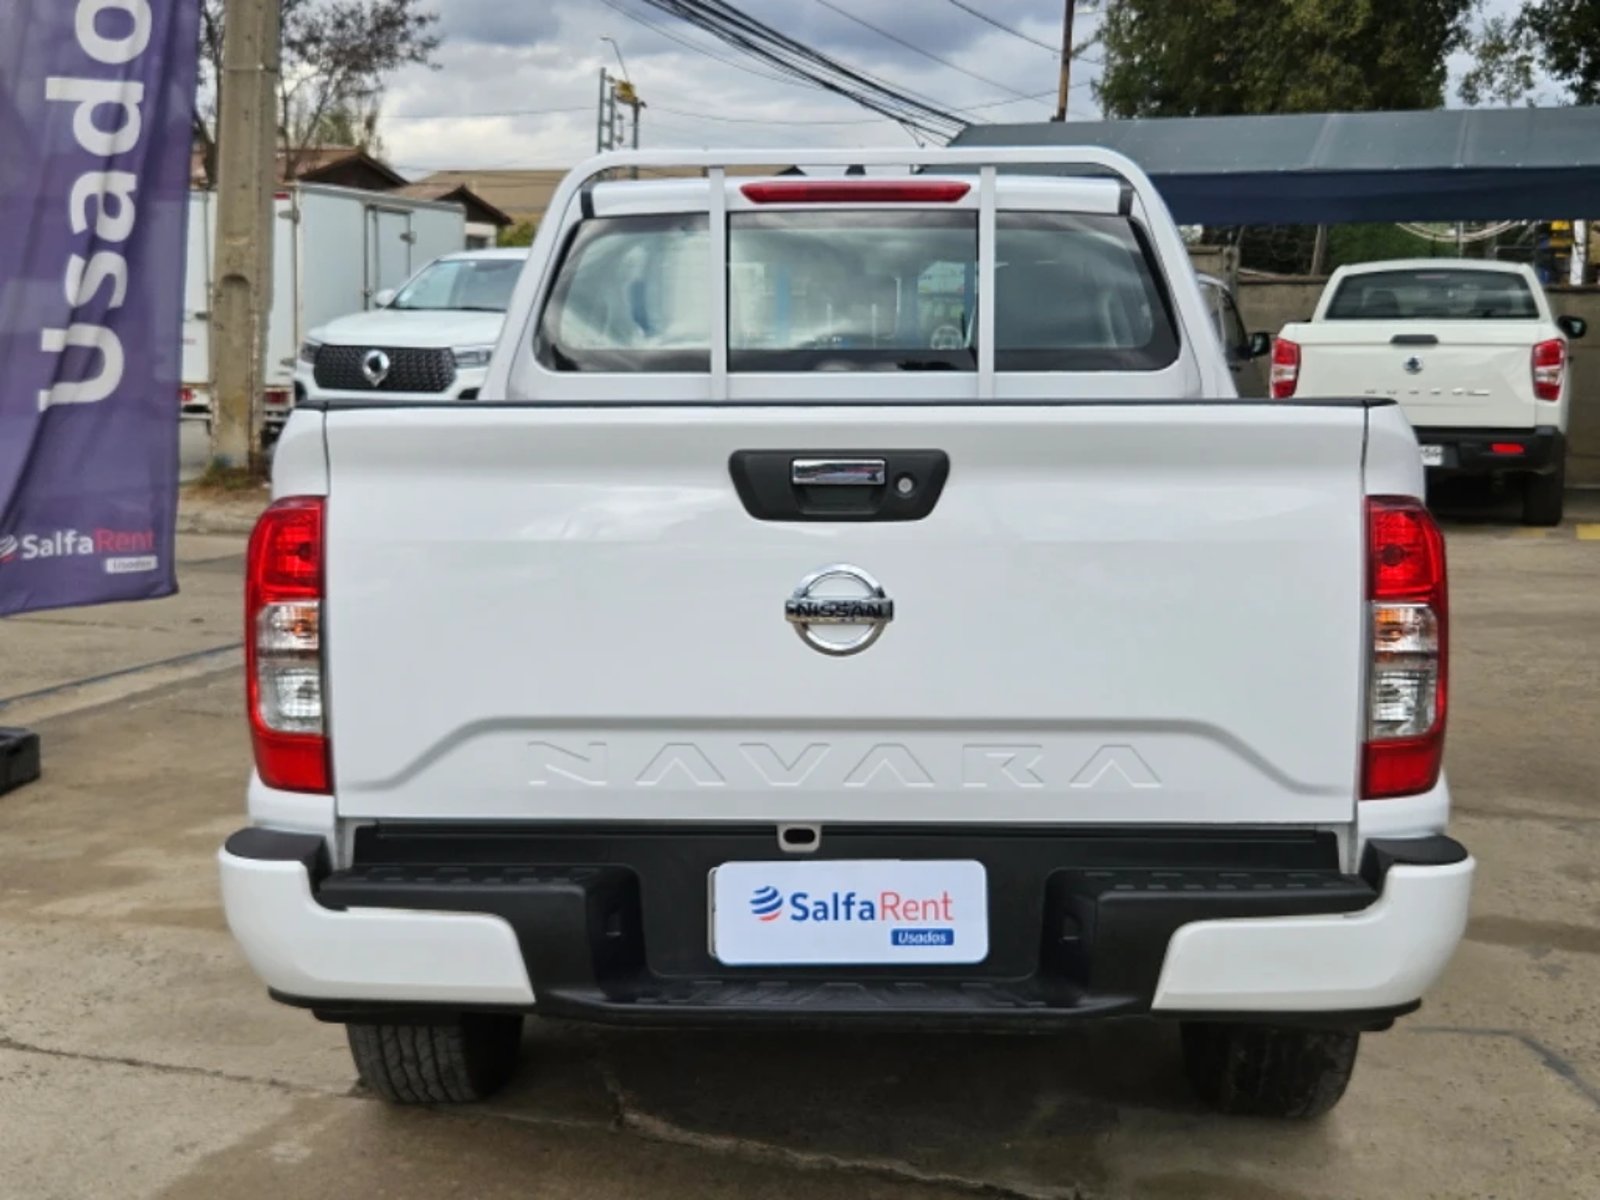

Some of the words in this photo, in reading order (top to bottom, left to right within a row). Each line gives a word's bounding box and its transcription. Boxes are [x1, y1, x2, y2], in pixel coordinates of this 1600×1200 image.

[22, 528, 155, 559] SalfaRent
[796, 602, 882, 618] NISSAN
[527, 741, 1162, 788] NAVARA
[790, 891, 954, 921] SalfaRent
[898, 930, 946, 944] Usados
